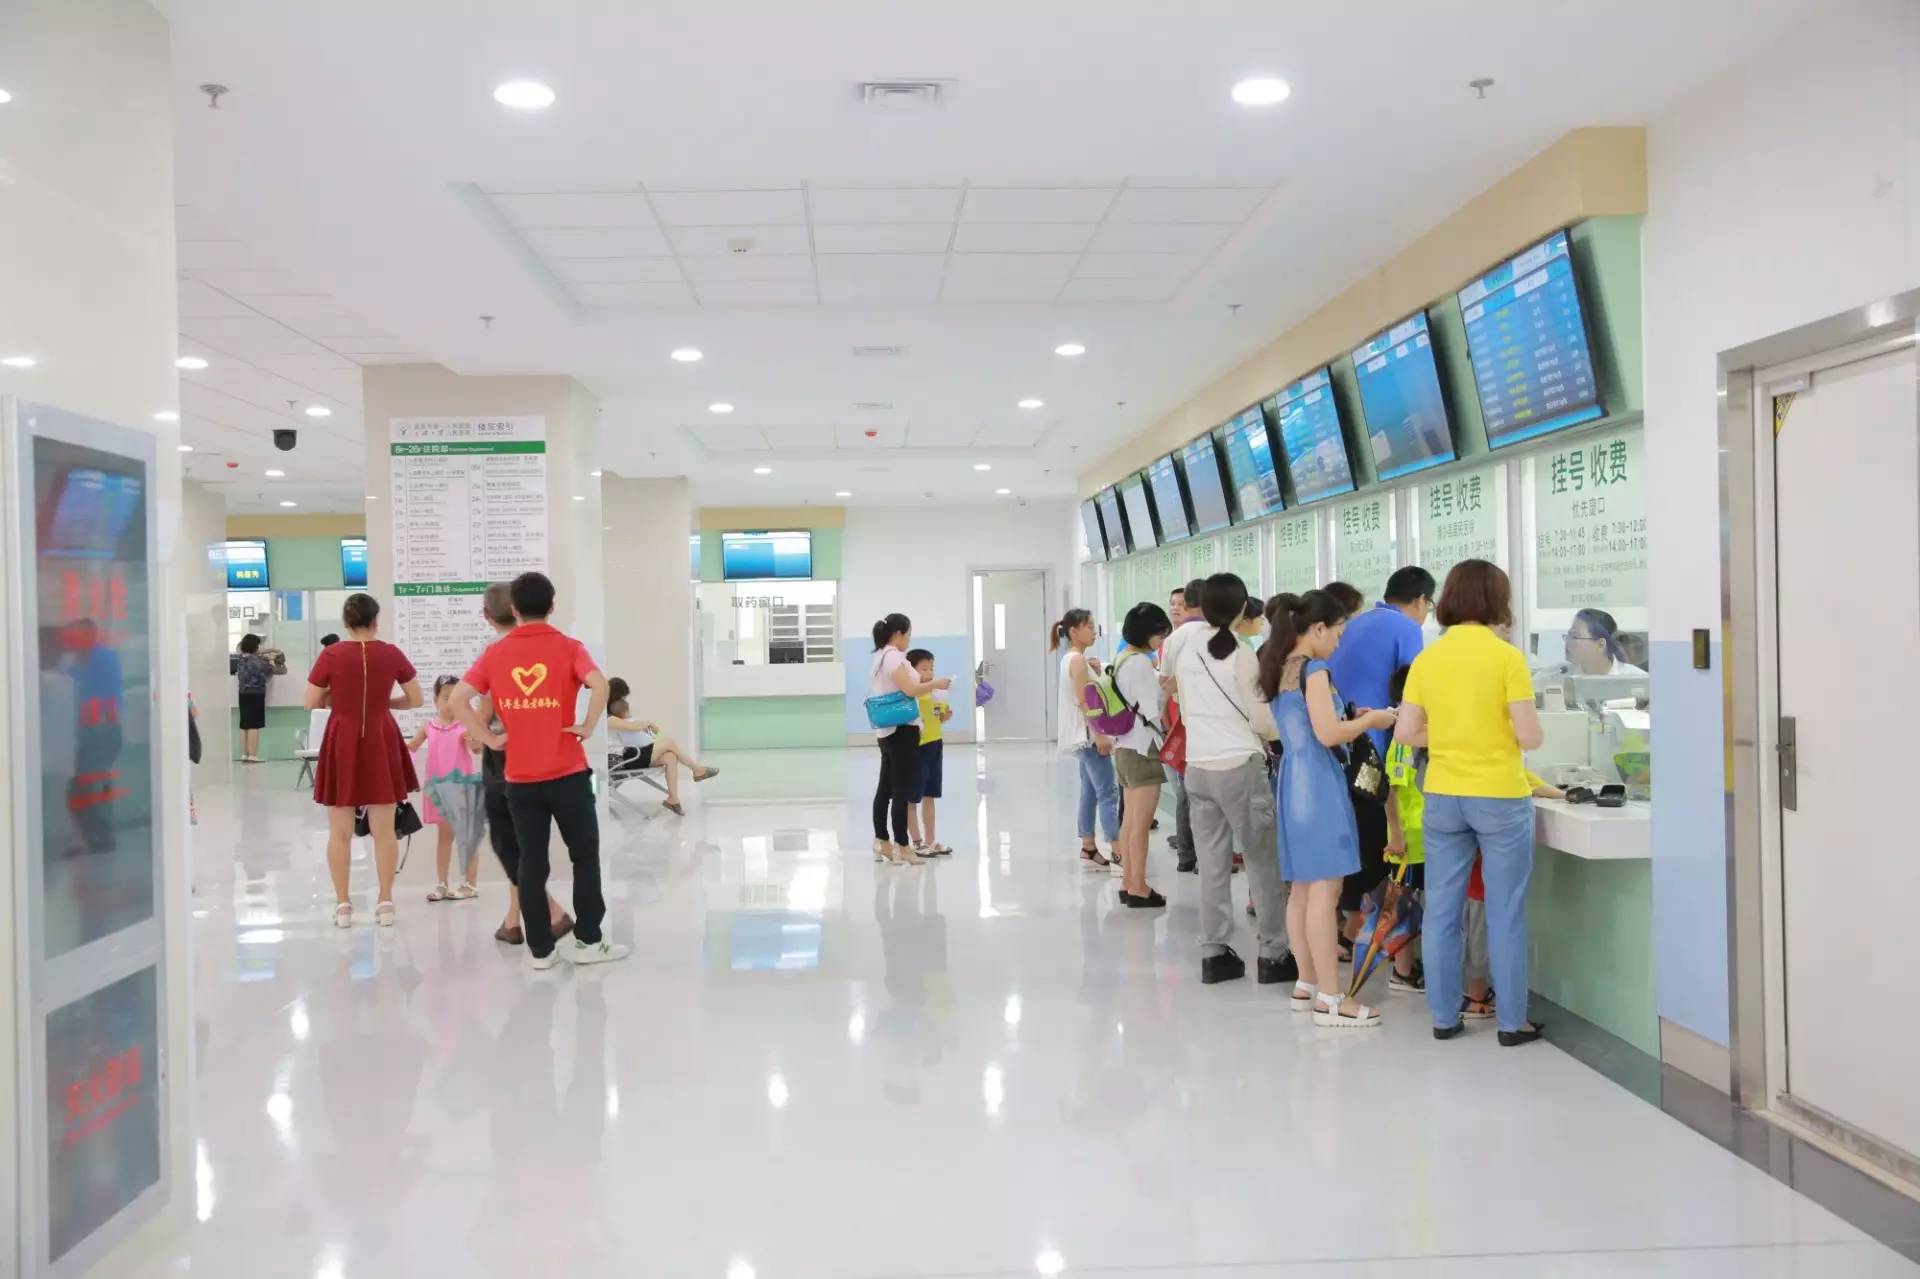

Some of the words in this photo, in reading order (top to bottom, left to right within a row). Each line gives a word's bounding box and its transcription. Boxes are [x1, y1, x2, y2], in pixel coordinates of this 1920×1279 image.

[1551, 450, 1585, 495] 挂号
[1590, 438, 1627, 487] 收费
[1430, 483, 1454, 519] 挂号
[1456, 473, 1482, 514] 收费
[1343, 505, 1361, 536] 挂号
[1362, 501, 1381, 532] 收费
[731, 595, 784, 608] 取药窗口
